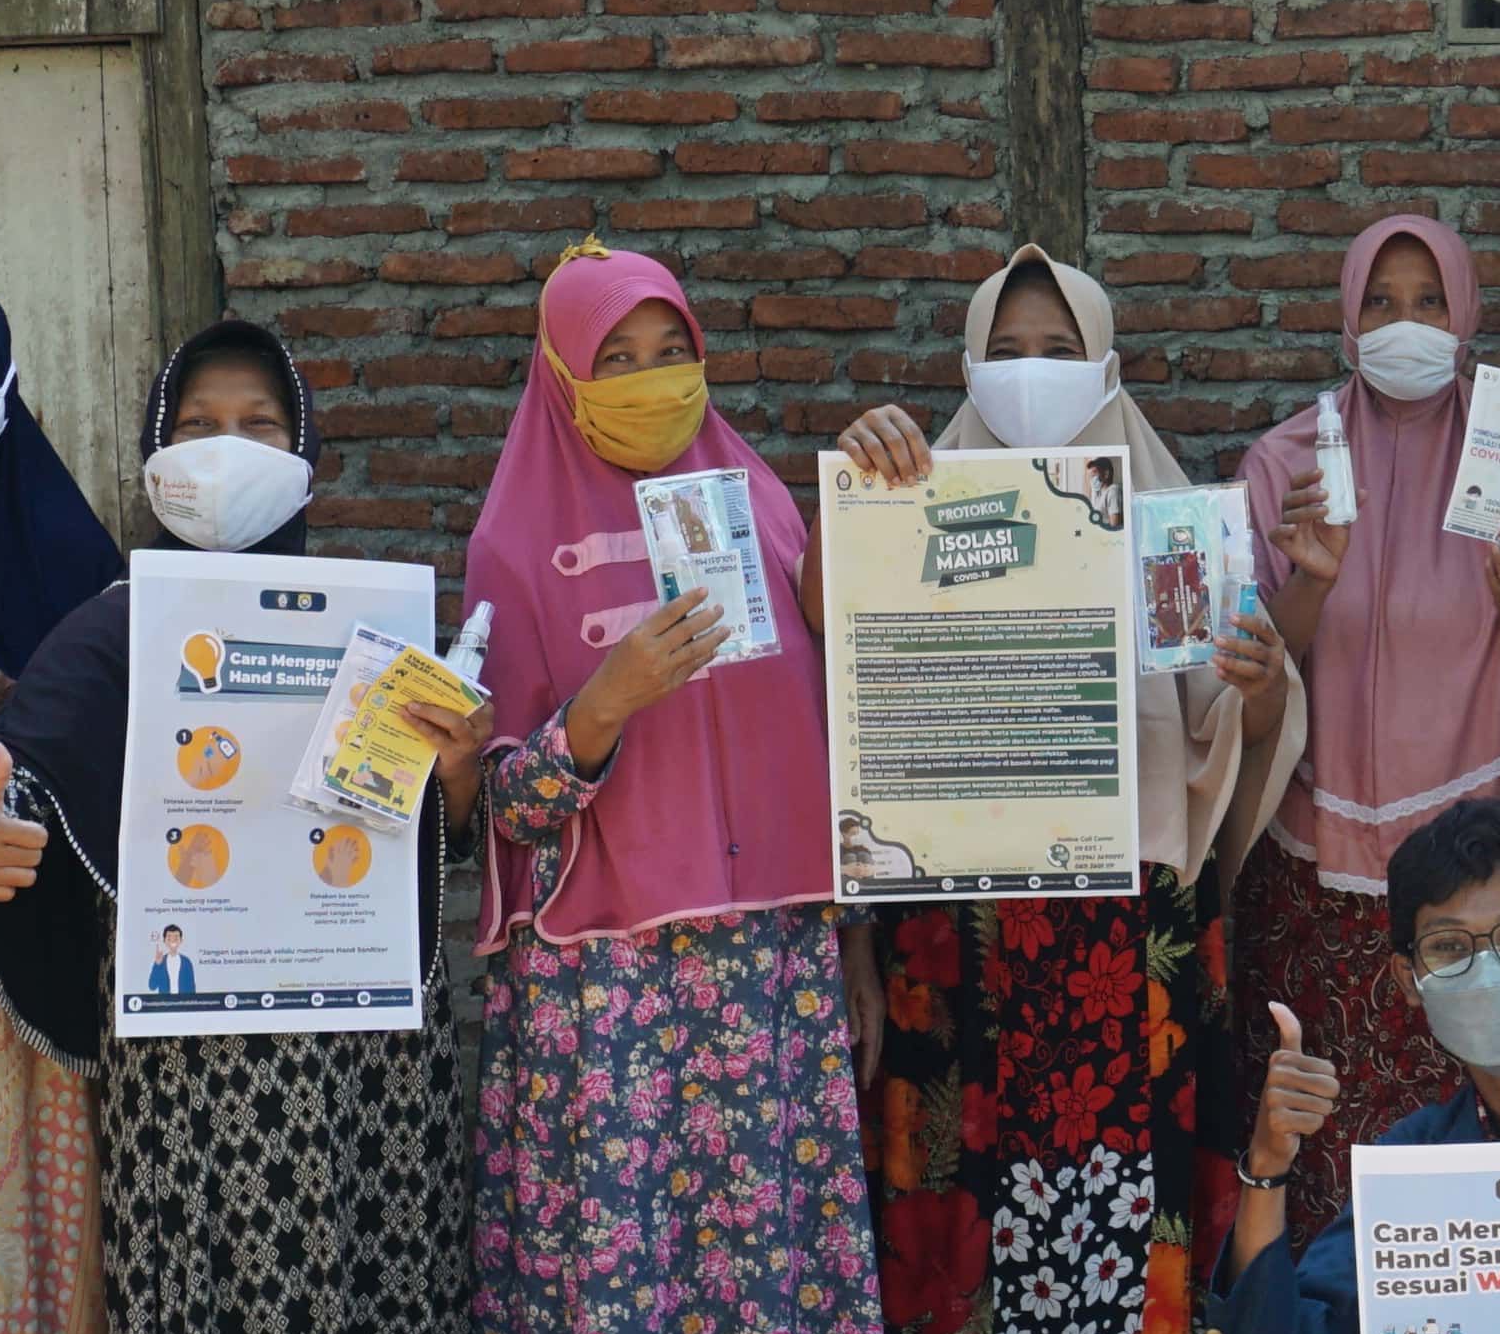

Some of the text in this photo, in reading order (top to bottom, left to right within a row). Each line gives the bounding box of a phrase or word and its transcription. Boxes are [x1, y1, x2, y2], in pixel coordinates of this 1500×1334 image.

[937, 500, 1006, 521] PROTOKOL
[939, 529, 1013, 552] ISOLASI
[936, 546, 1019, 570] MANDIRI
[953, 571, 990, 583] COVID-19
[845, 634, 853, 644] 2
[230, 652, 267, 666] Cara
[229, 670, 272, 684] Hand
[850, 761, 857, 771] 7
[1373, 1223, 1438, 1242] Cara
[1375, 1248, 1450, 1269] Hand
[1376, 1271, 1467, 1295] sesuai
